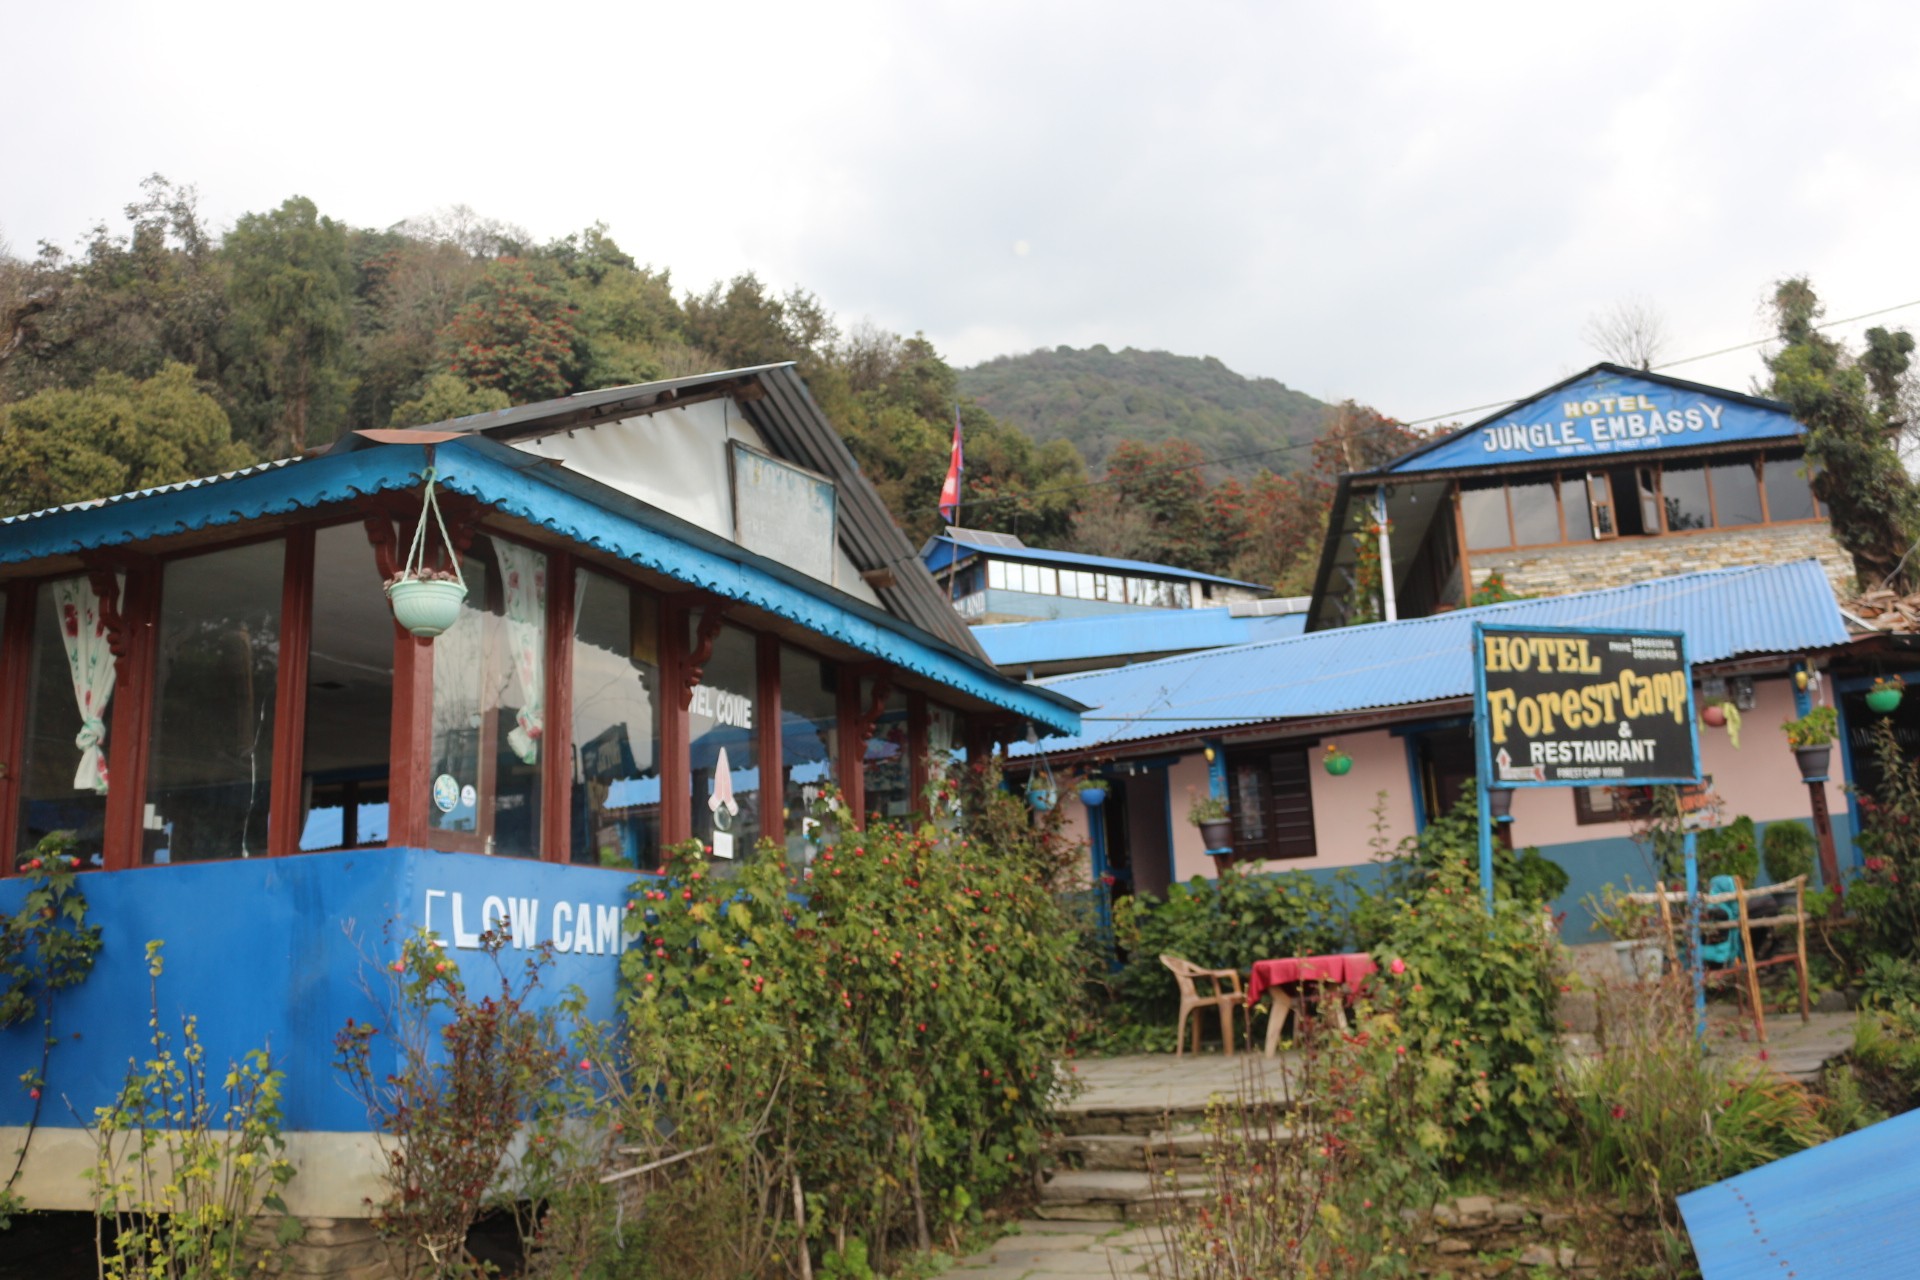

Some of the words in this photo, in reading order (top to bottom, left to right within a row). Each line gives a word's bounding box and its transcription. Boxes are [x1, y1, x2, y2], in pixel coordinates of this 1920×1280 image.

[1563, 394, 1656, 418] HOTEL
[1483, 421, 1585, 452] JUNGLE
[1591, 402, 1724, 443] EMBASSY
[1484, 636, 1601, 674] HOTEL
[1618, 721, 1632, 738] &
[1529, 739, 1656, 764] RESTAURANT
